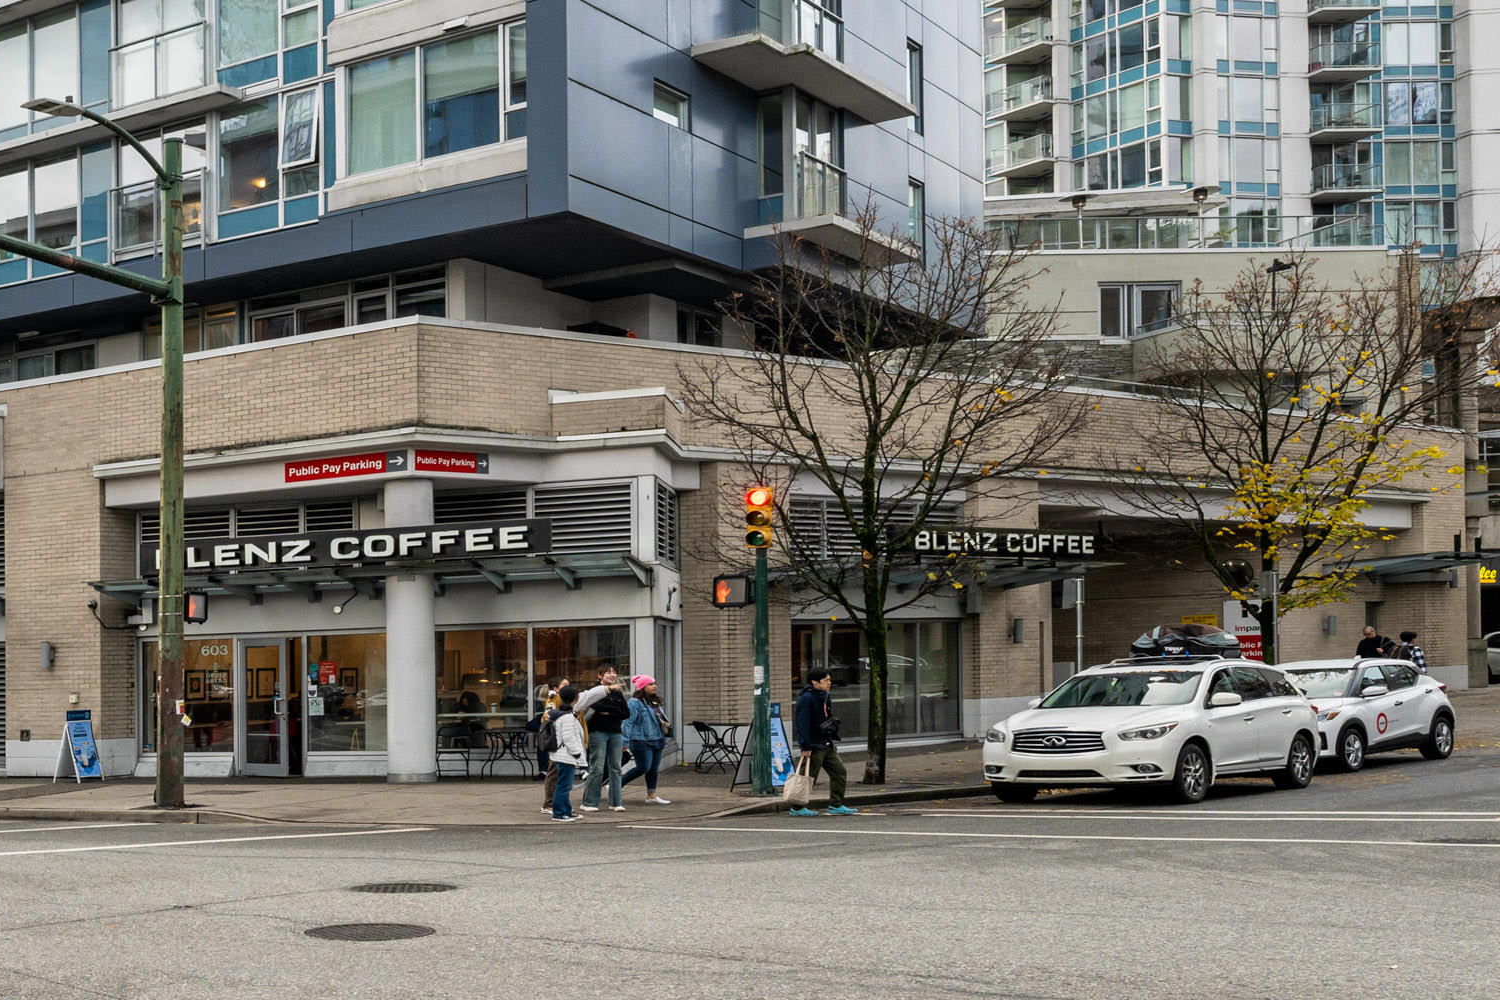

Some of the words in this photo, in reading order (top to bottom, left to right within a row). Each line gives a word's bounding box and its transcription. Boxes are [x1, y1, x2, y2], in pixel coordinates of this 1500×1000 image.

[288, 464, 320, 478] Public
[322, 462, 341, 476] Pay
[343, 459, 383, 472] Parking
[416, 456, 437, 465] Public
[438, 457, 451, 467] Pay
[451, 458, 475, 468] Parking
[156, 540, 311, 569] LENZ
[329, 526, 529, 560] COFFEE
[915, 531, 998, 552] BLENZ
[1006, 533, 1095, 554] COFFEE
[201, 645, 228, 656] 603
